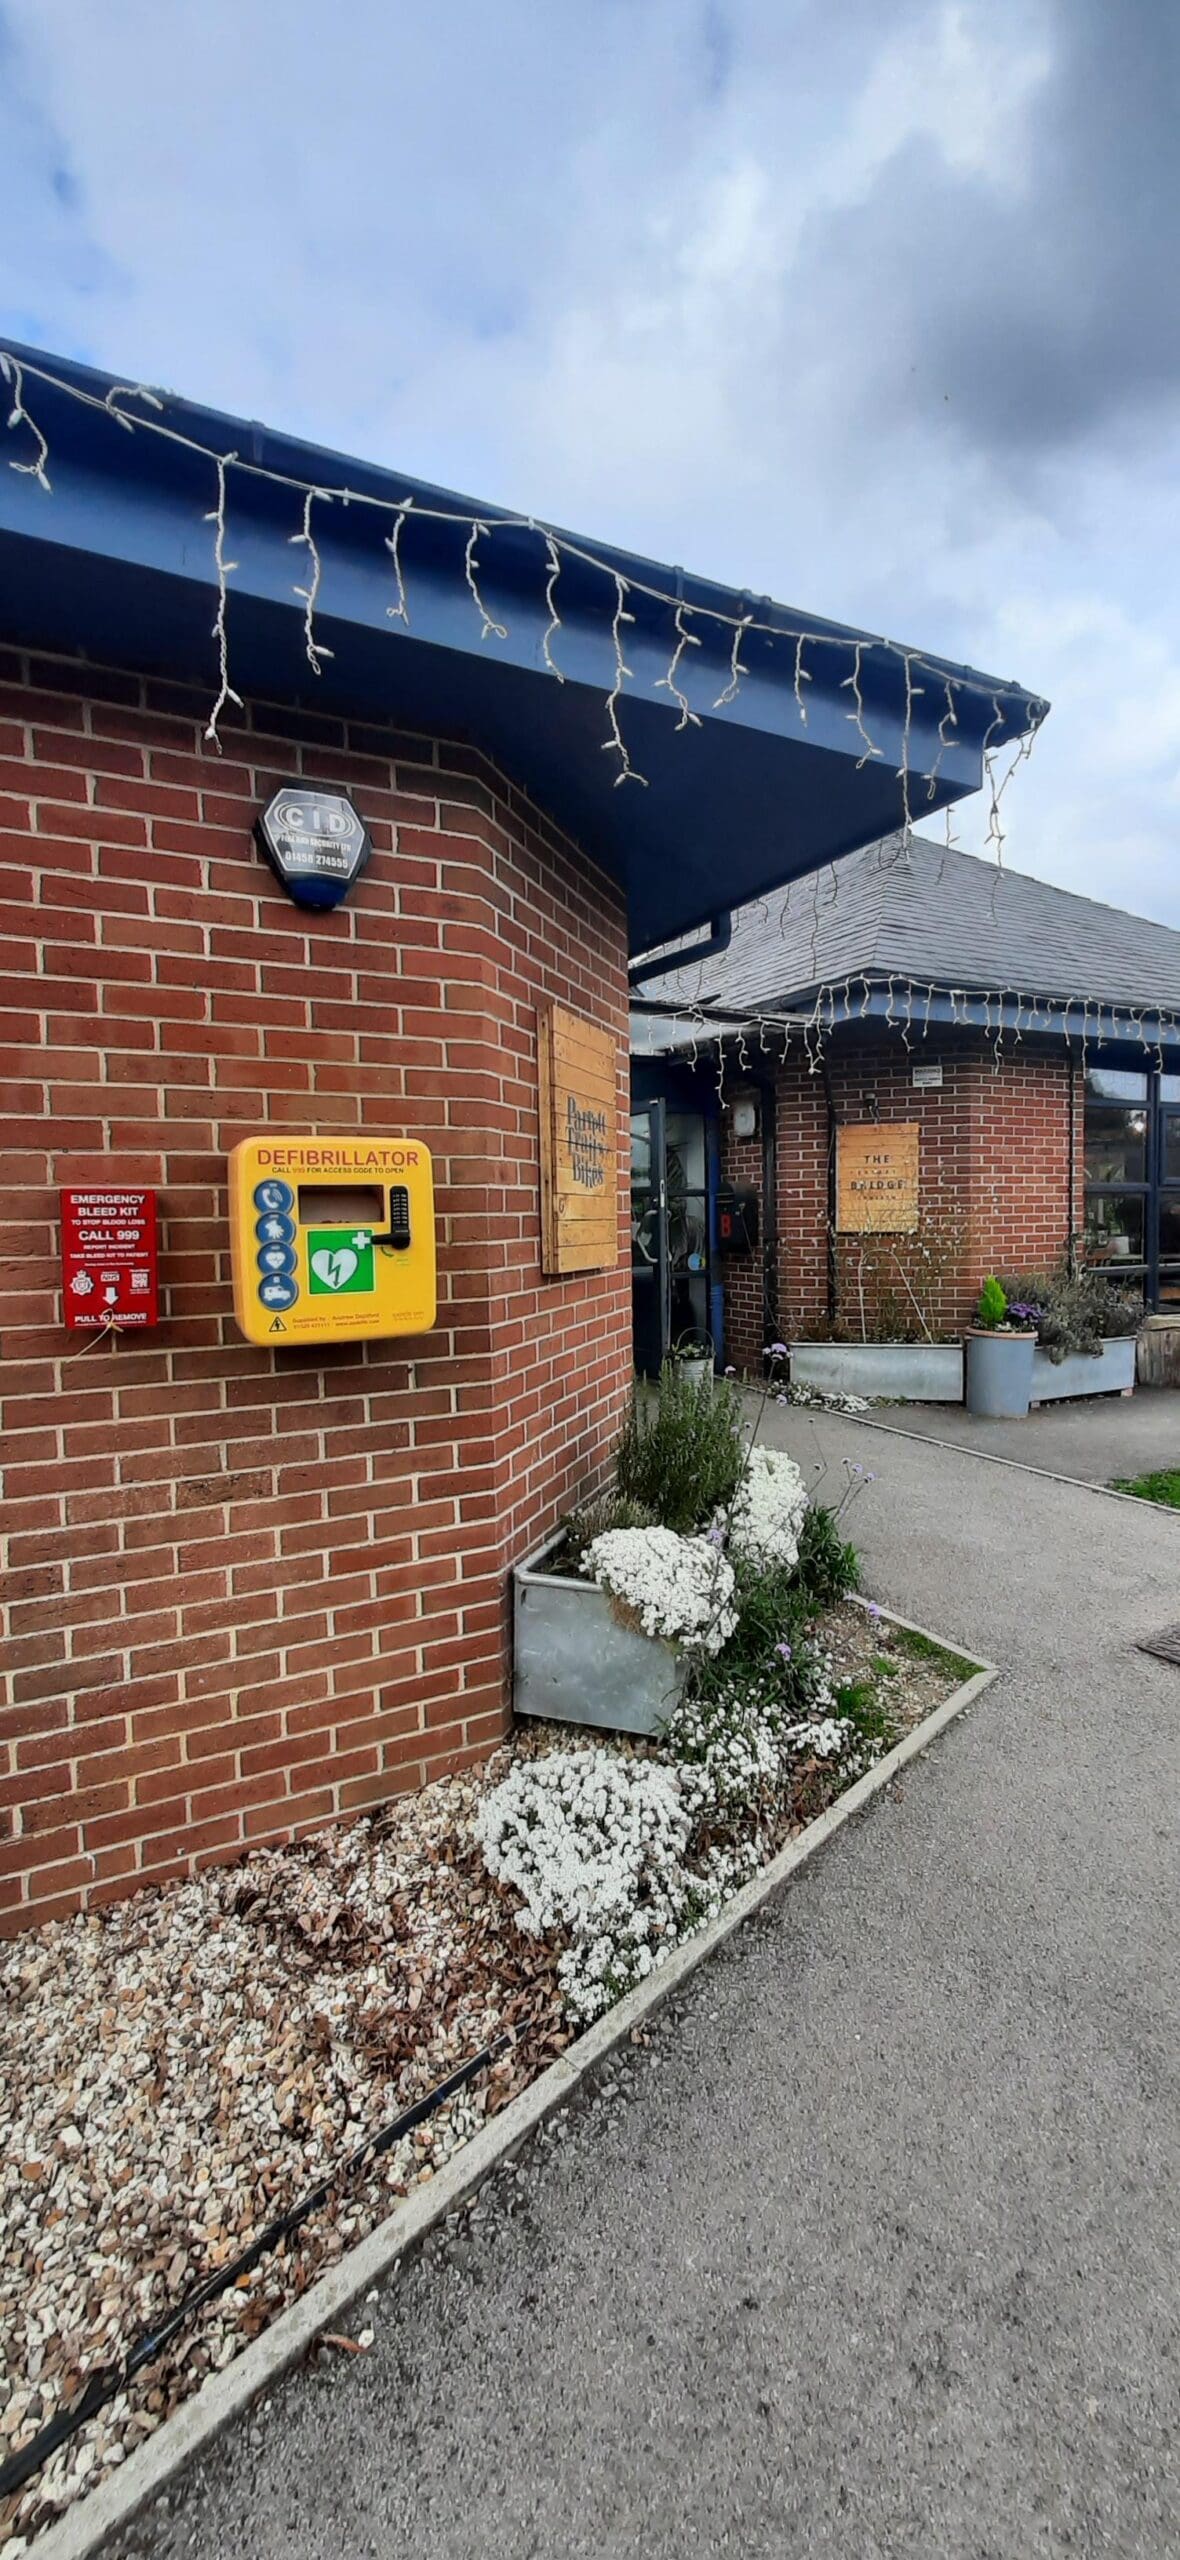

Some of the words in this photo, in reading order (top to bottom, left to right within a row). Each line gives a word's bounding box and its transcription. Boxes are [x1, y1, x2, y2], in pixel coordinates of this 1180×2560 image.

[257, 1149, 419, 1166] DEFIBRILLATOR
[864, 1154, 890, 1164] THE
[572, 1152, 604, 1188] Bikes
[850, 1179, 905, 1191] BRIDGE
[70, 1194, 145, 1204] EMERGENCY
[78, 1206, 117, 1216] BLEED
[119, 1206, 138, 1216] KIT
[78, 1230, 114, 1241] CALL
[116, 1230, 140, 1241] 999
[74, 1314, 97, 1323] PULL
[98, 1313, 110, 1322] TO
[112, 1311, 148, 1321] REMOVE
